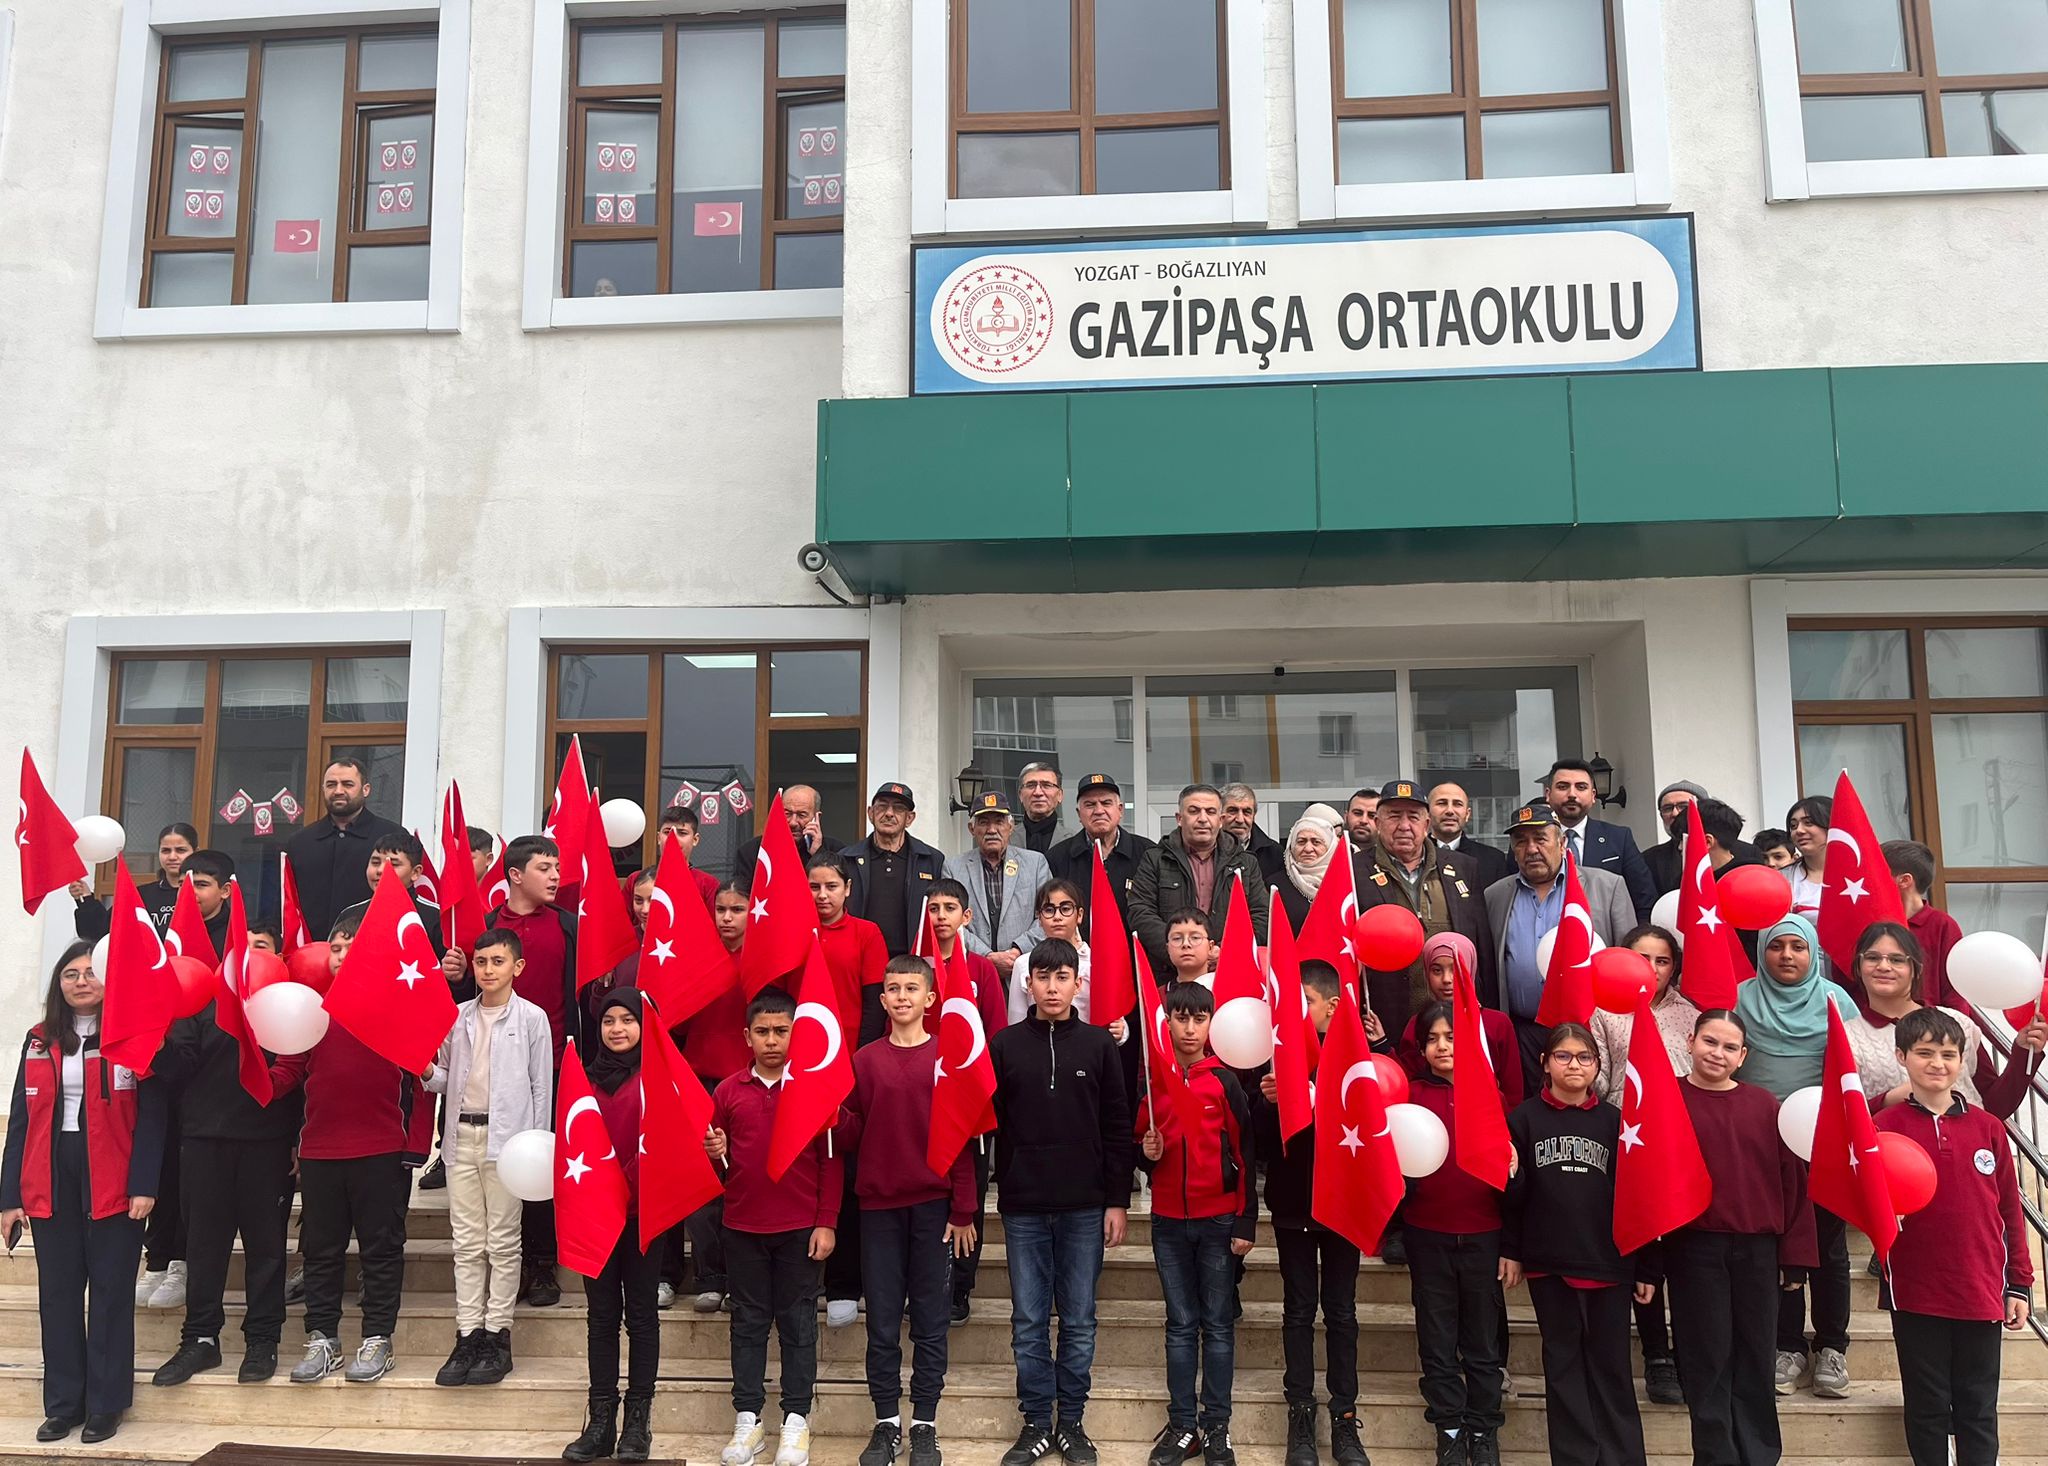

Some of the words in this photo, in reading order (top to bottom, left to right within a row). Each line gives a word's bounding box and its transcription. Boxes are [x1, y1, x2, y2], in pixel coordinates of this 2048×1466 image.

[1074, 265, 1140, 282] YOZGAT
[1157, 260, 1267, 279] BOĞAZLIYAN
[965, 329, 991, 352] TÜRKİYE
[995, 284, 1016, 293] MİLLİ
[1069, 285, 1314, 370] GAZİPAŞA
[1337, 281, 1644, 350] ORTAOKULU
[1534, 1135, 1610, 1175] CALIFORNIA
